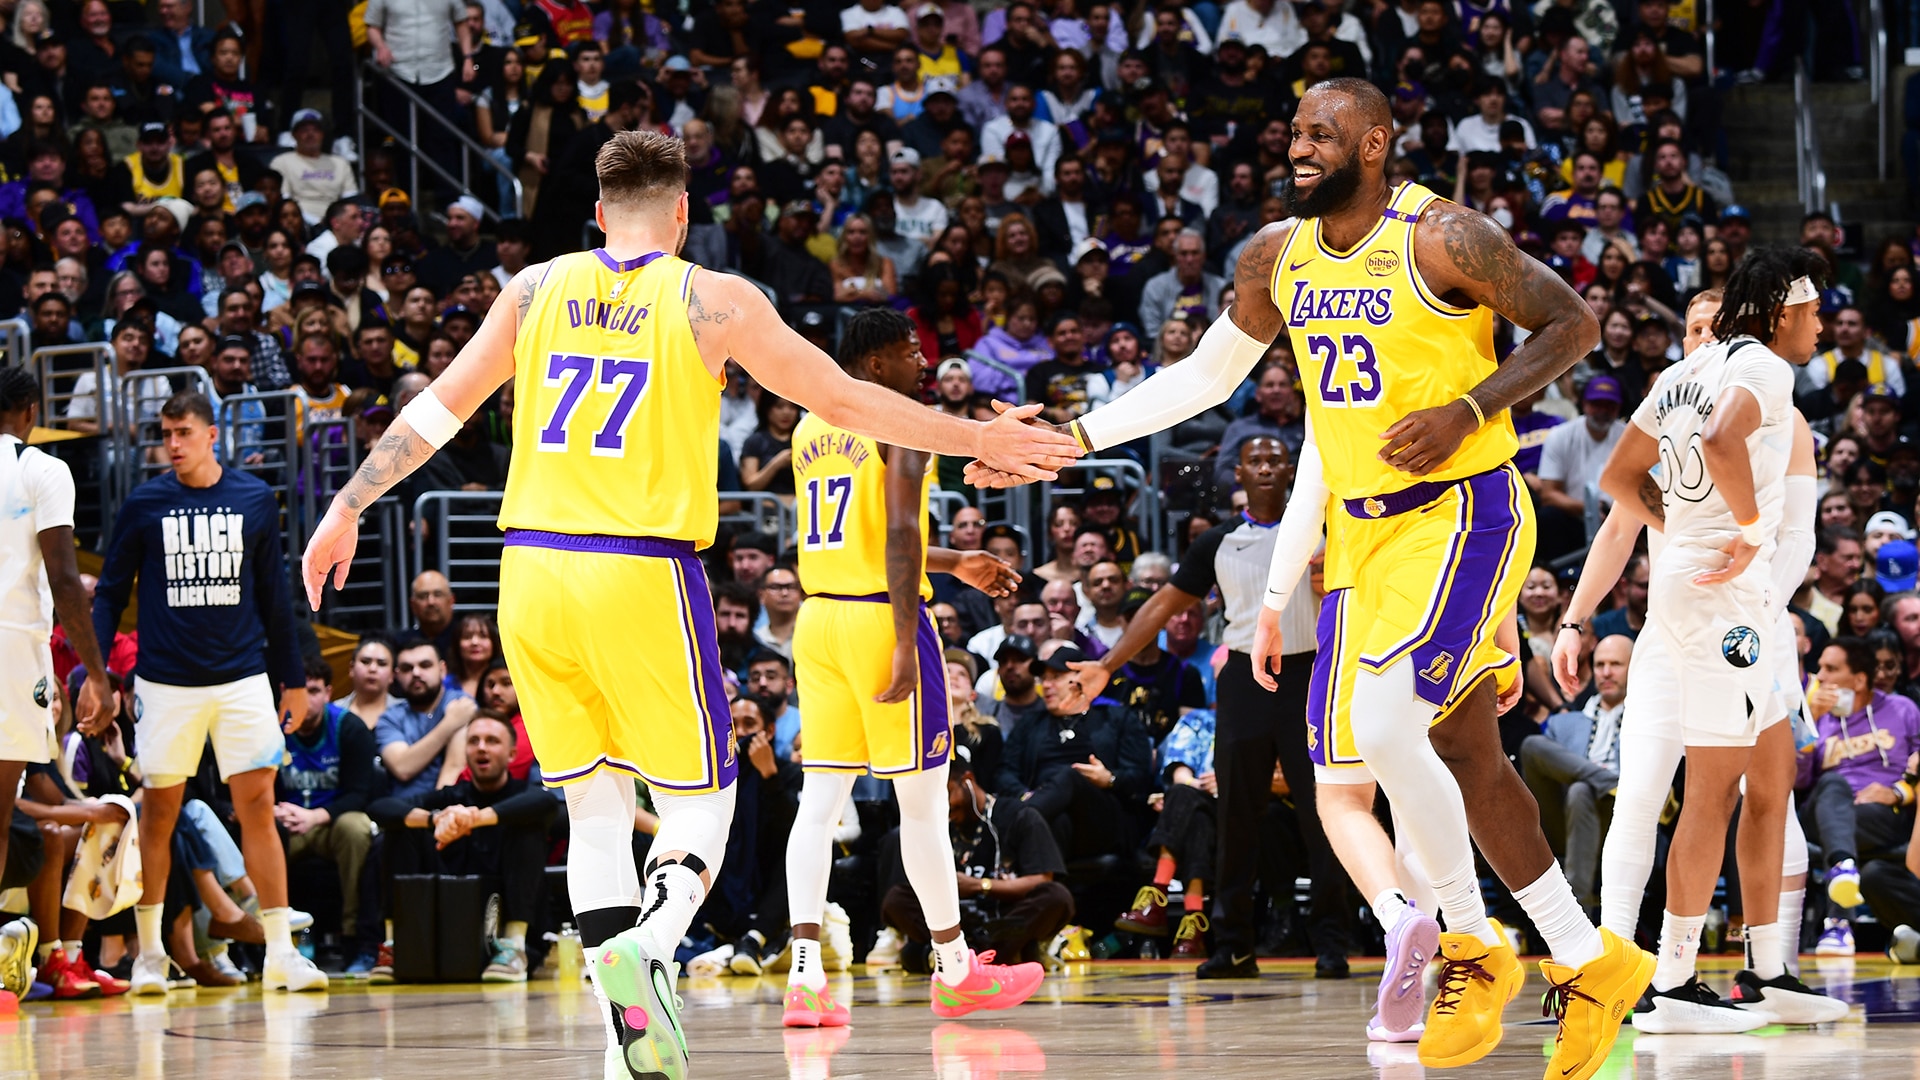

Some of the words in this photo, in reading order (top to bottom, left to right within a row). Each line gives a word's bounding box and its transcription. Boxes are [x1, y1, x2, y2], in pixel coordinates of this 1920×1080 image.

[1368, 257, 1398, 269] bibigo
[566, 298, 652, 335] DONČIĆ
[1287, 279, 1394, 328] LAKERS
[1306, 332, 1384, 409] 23
[537, 351, 653, 459] 77
[795, 433, 870, 476] FINNEY-SMITH
[161, 513, 244, 555] BLACK
[804, 474, 852, 552] 17
[164, 551, 243, 581] HISTORY
[166, 585, 206, 607] BLACK
